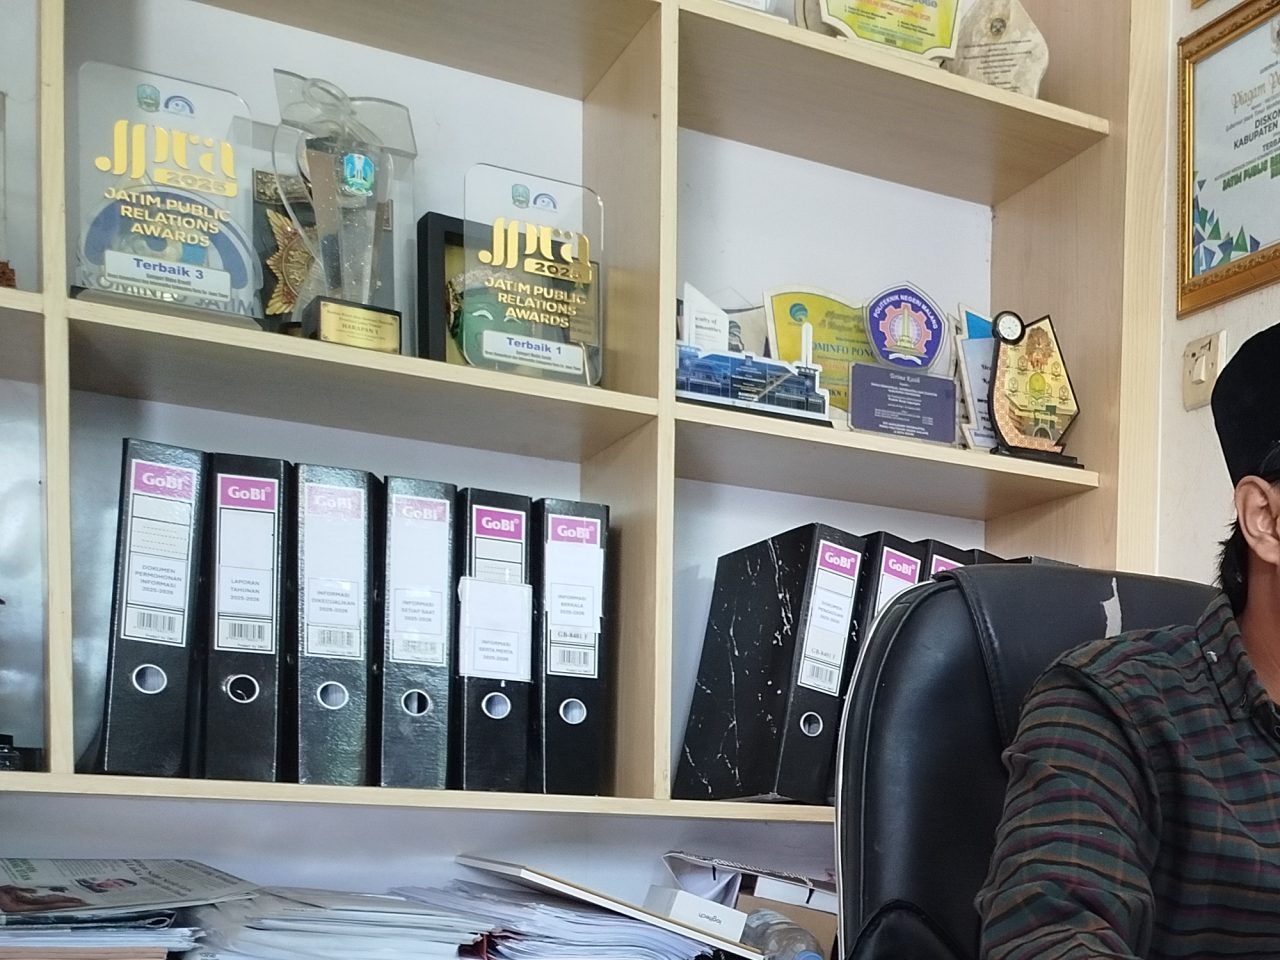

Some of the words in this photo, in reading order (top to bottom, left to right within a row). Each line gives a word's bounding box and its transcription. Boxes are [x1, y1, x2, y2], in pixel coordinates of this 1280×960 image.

[1234, 120, 1278, 150] KABUPATEN
[104, 187, 160, 207] JATIM
[166, 199, 230, 221] PUBLIC
[121, 205, 220, 233] RELATIONS
[132, 224, 210, 247] AWARDS
[133, 258, 190, 277] Terbaik
[195, 270, 204, 280] 3
[485, 277, 530, 294] JATIM
[534, 286, 586, 304] PUBLIC
[498, 293, 577, 315] RELATIONS
[874, 295, 899, 318] POLITEKNIK
[900, 295, 922, 307] NEGERI
[922, 304, 938, 329] MALANG
[506, 308, 569, 328] AWARDS
[507, 337, 551, 353] Terbaik
